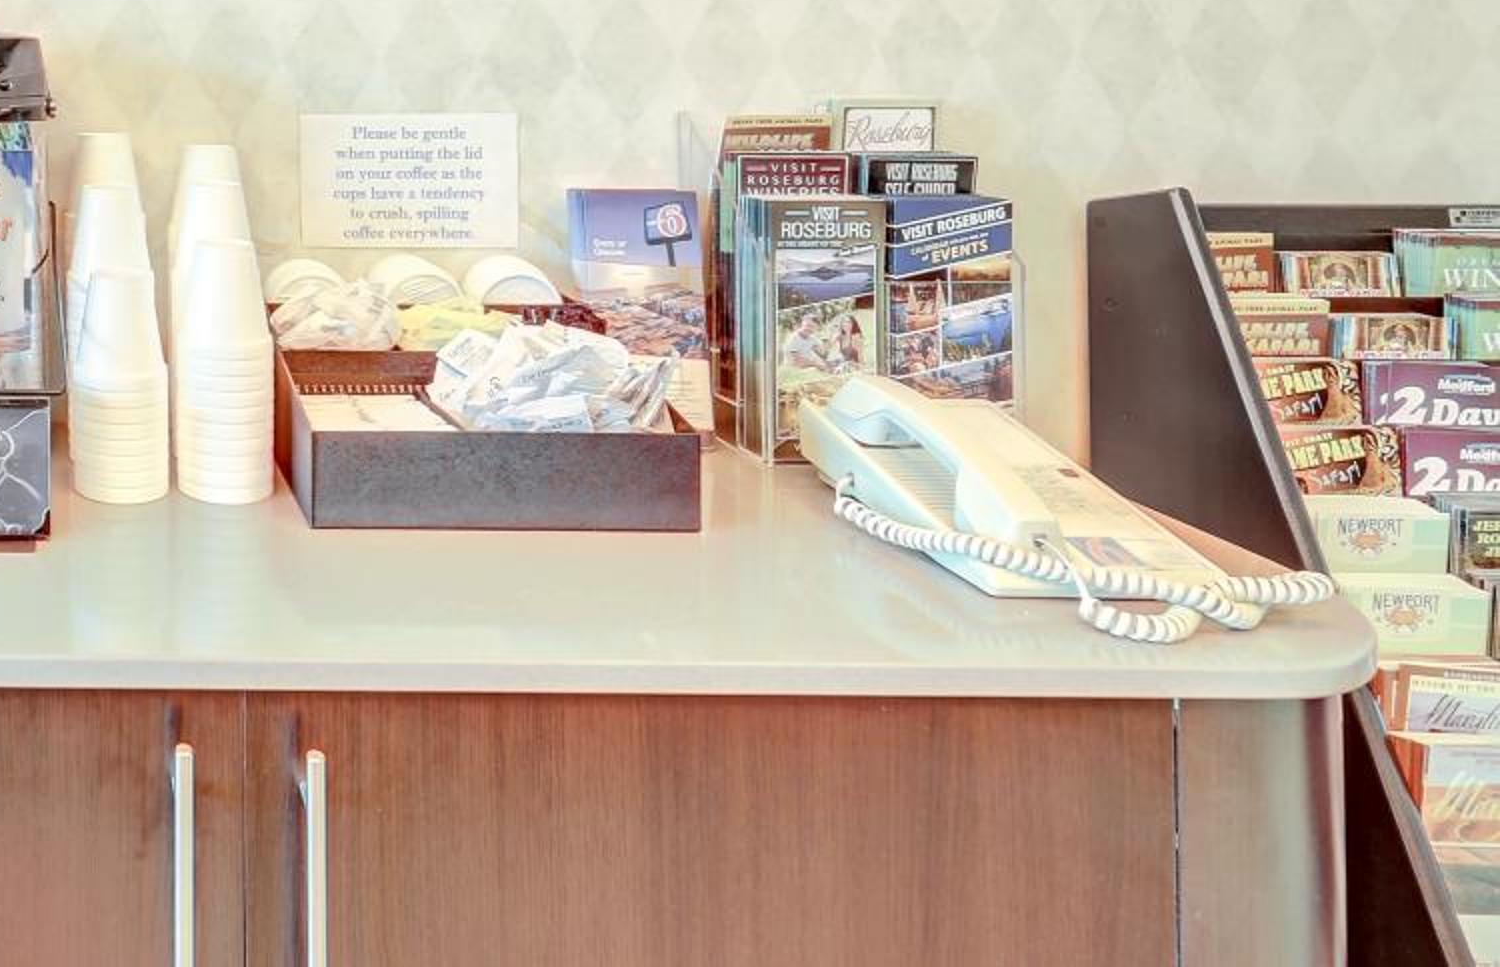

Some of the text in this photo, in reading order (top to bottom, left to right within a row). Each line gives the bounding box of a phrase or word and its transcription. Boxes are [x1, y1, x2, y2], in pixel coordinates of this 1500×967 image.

[352, 126, 466, 143] Please be gentle
[847, 111, 932, 151] Roseburg
[335, 146, 482, 163] when putting the lid
[335, 166, 482, 184] on your coffee as the
[771, 163, 818, 173] VISIT
[747, 175, 840, 186] ROSEBURG
[332, 187, 485, 204] cups have a tendency
[350, 206, 469, 223] to crush, spilling
[657, 204, 688, 238] 6
[812, 206, 840, 221] VISIT
[781, 221, 872, 240] ROSEBURG
[902, 222, 934, 241] VISIT
[937, 207, 1006, 233] ROSEBURG
[343, 226, 473, 243] coffee everywhere.
[931, 238, 989, 264] EVENTS
[1282, 368, 1327, 396] PARK
[1388, 386, 1428, 426] 2
[1319, 435, 1366, 464] PARK
[1409, 456, 1451, 496] 2
[1338, 518, 1405, 538] NEWPORT
[1372, 592, 1441, 614] NEWPORT
